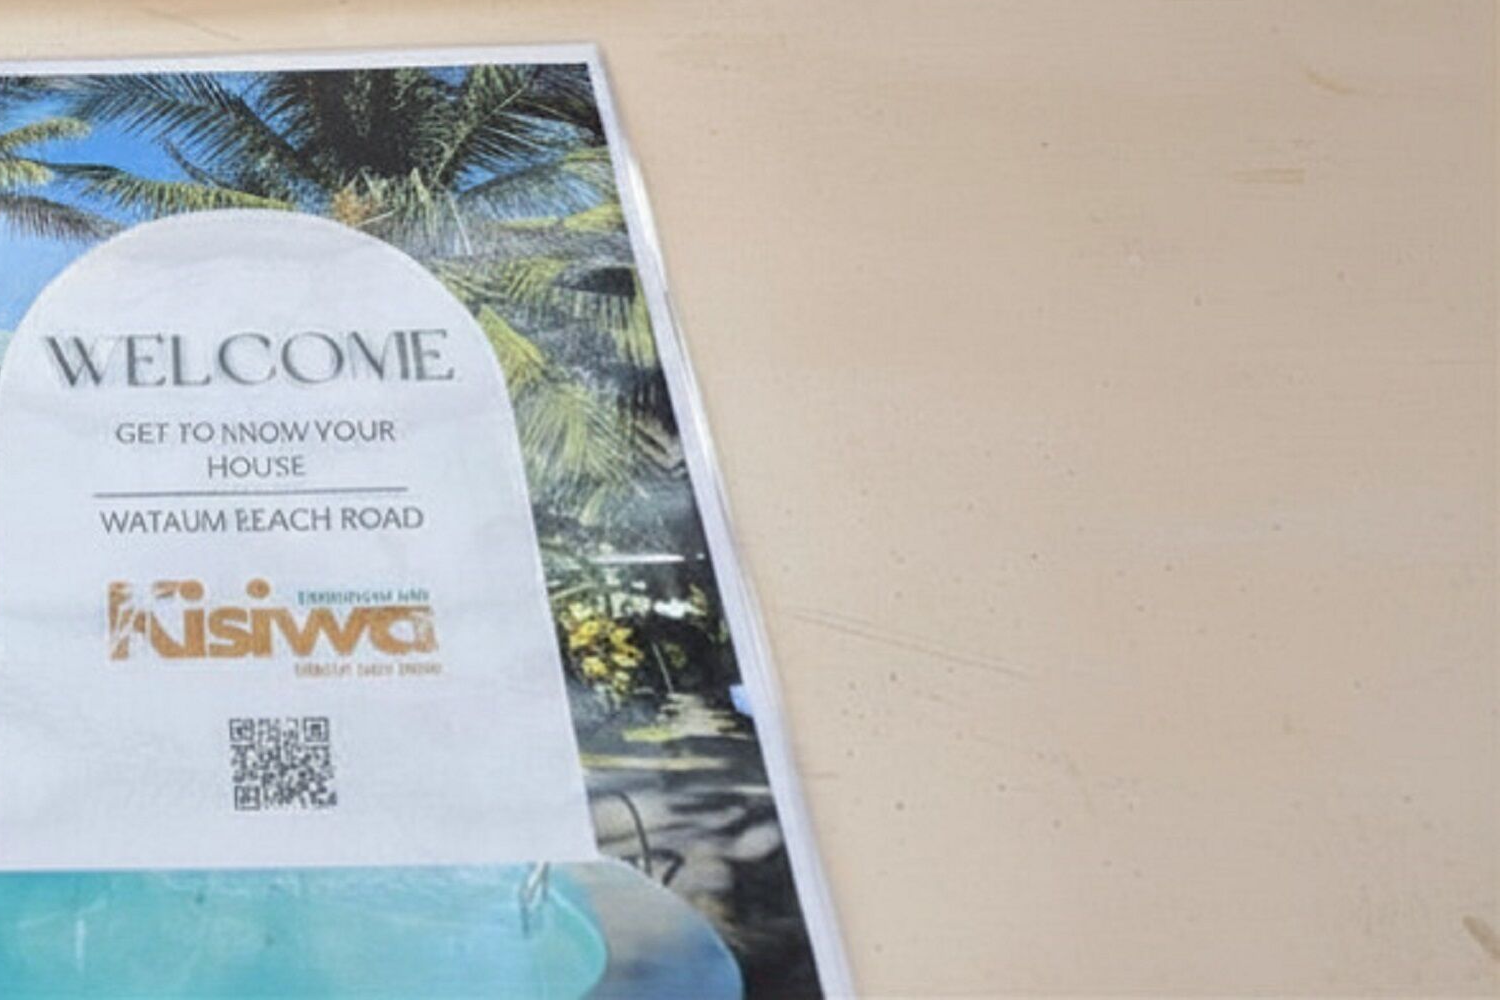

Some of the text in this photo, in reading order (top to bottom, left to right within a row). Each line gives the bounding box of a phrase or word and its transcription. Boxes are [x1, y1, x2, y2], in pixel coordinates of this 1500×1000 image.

[44, 328, 455, 389] WELCOME
[114, 422, 169, 445] GET
[179, 421, 215, 444] TO
[315, 419, 397, 443] YOUR
[206, 455, 306, 479] HOUSE
[340, 505, 425, 532] ROAD
